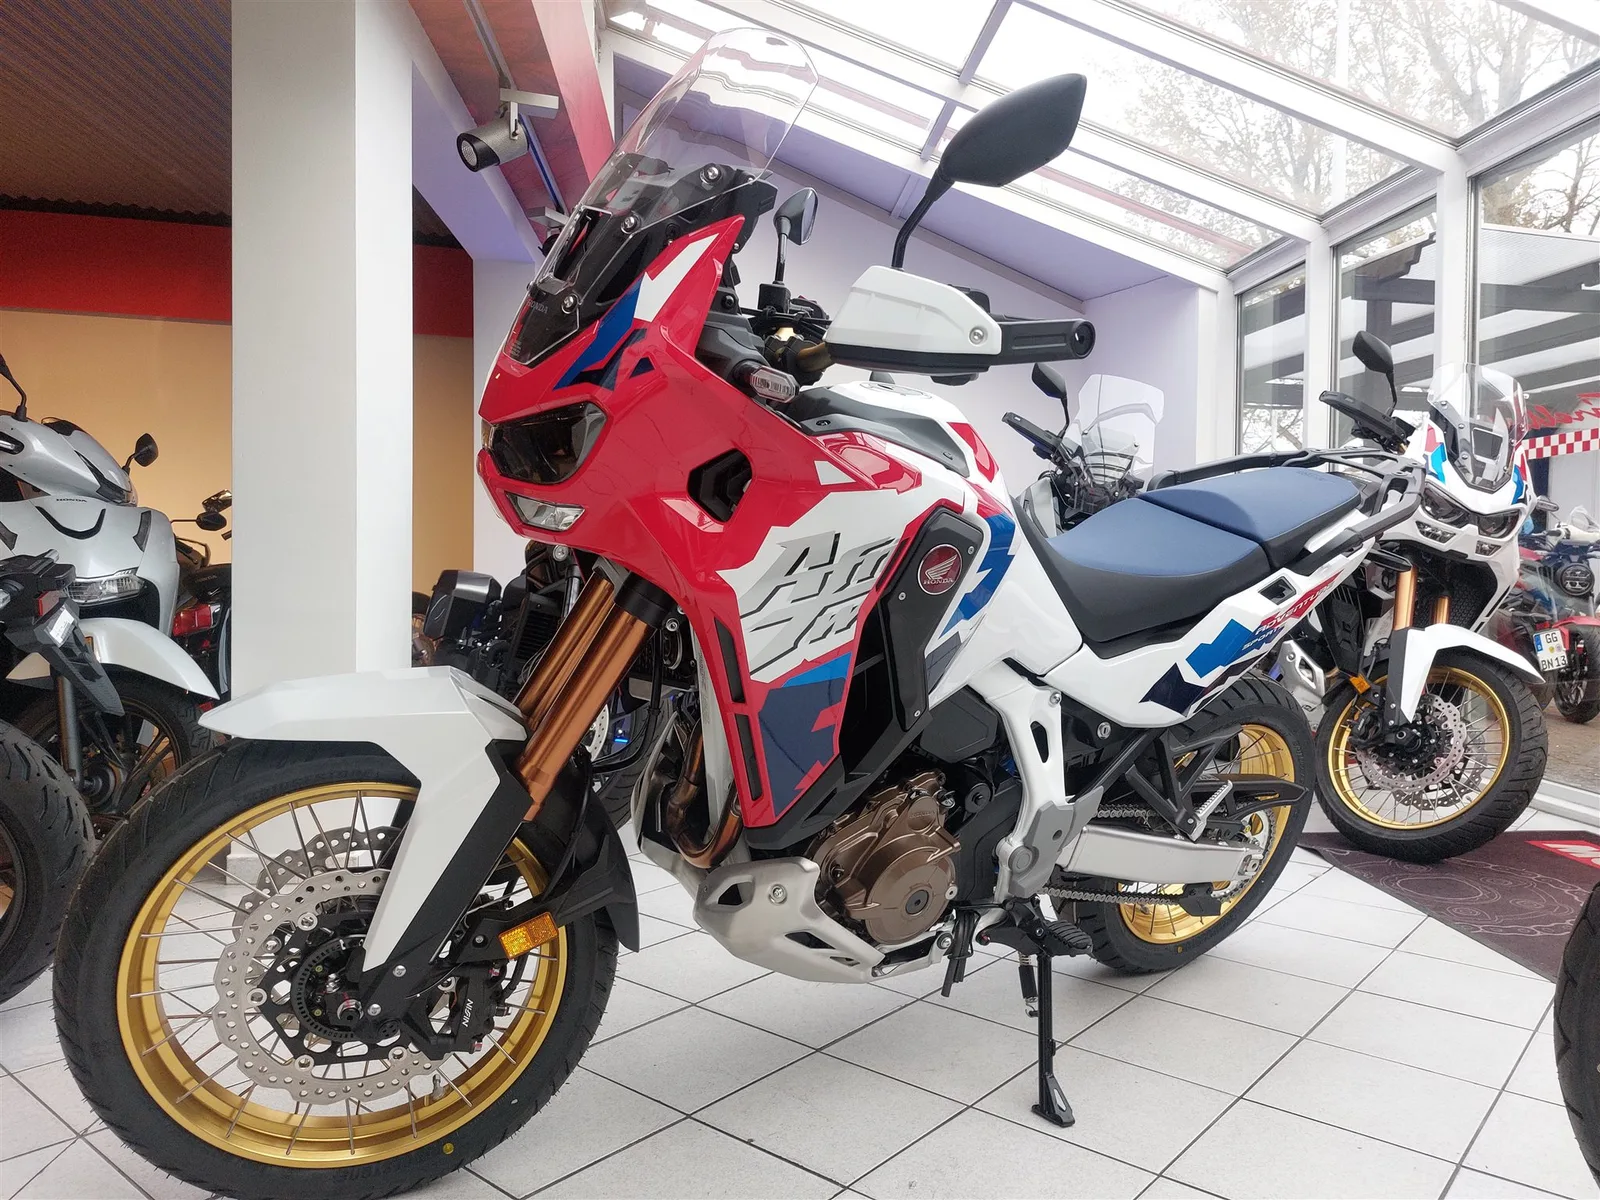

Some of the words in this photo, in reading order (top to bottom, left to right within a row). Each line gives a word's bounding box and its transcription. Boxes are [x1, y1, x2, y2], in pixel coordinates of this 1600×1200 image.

[923, 577, 954, 585] HONDA
[1544, 632, 1558, 644] GG
[1541, 657, 1554, 670] BN
[1555, 655, 1567, 667] 13
